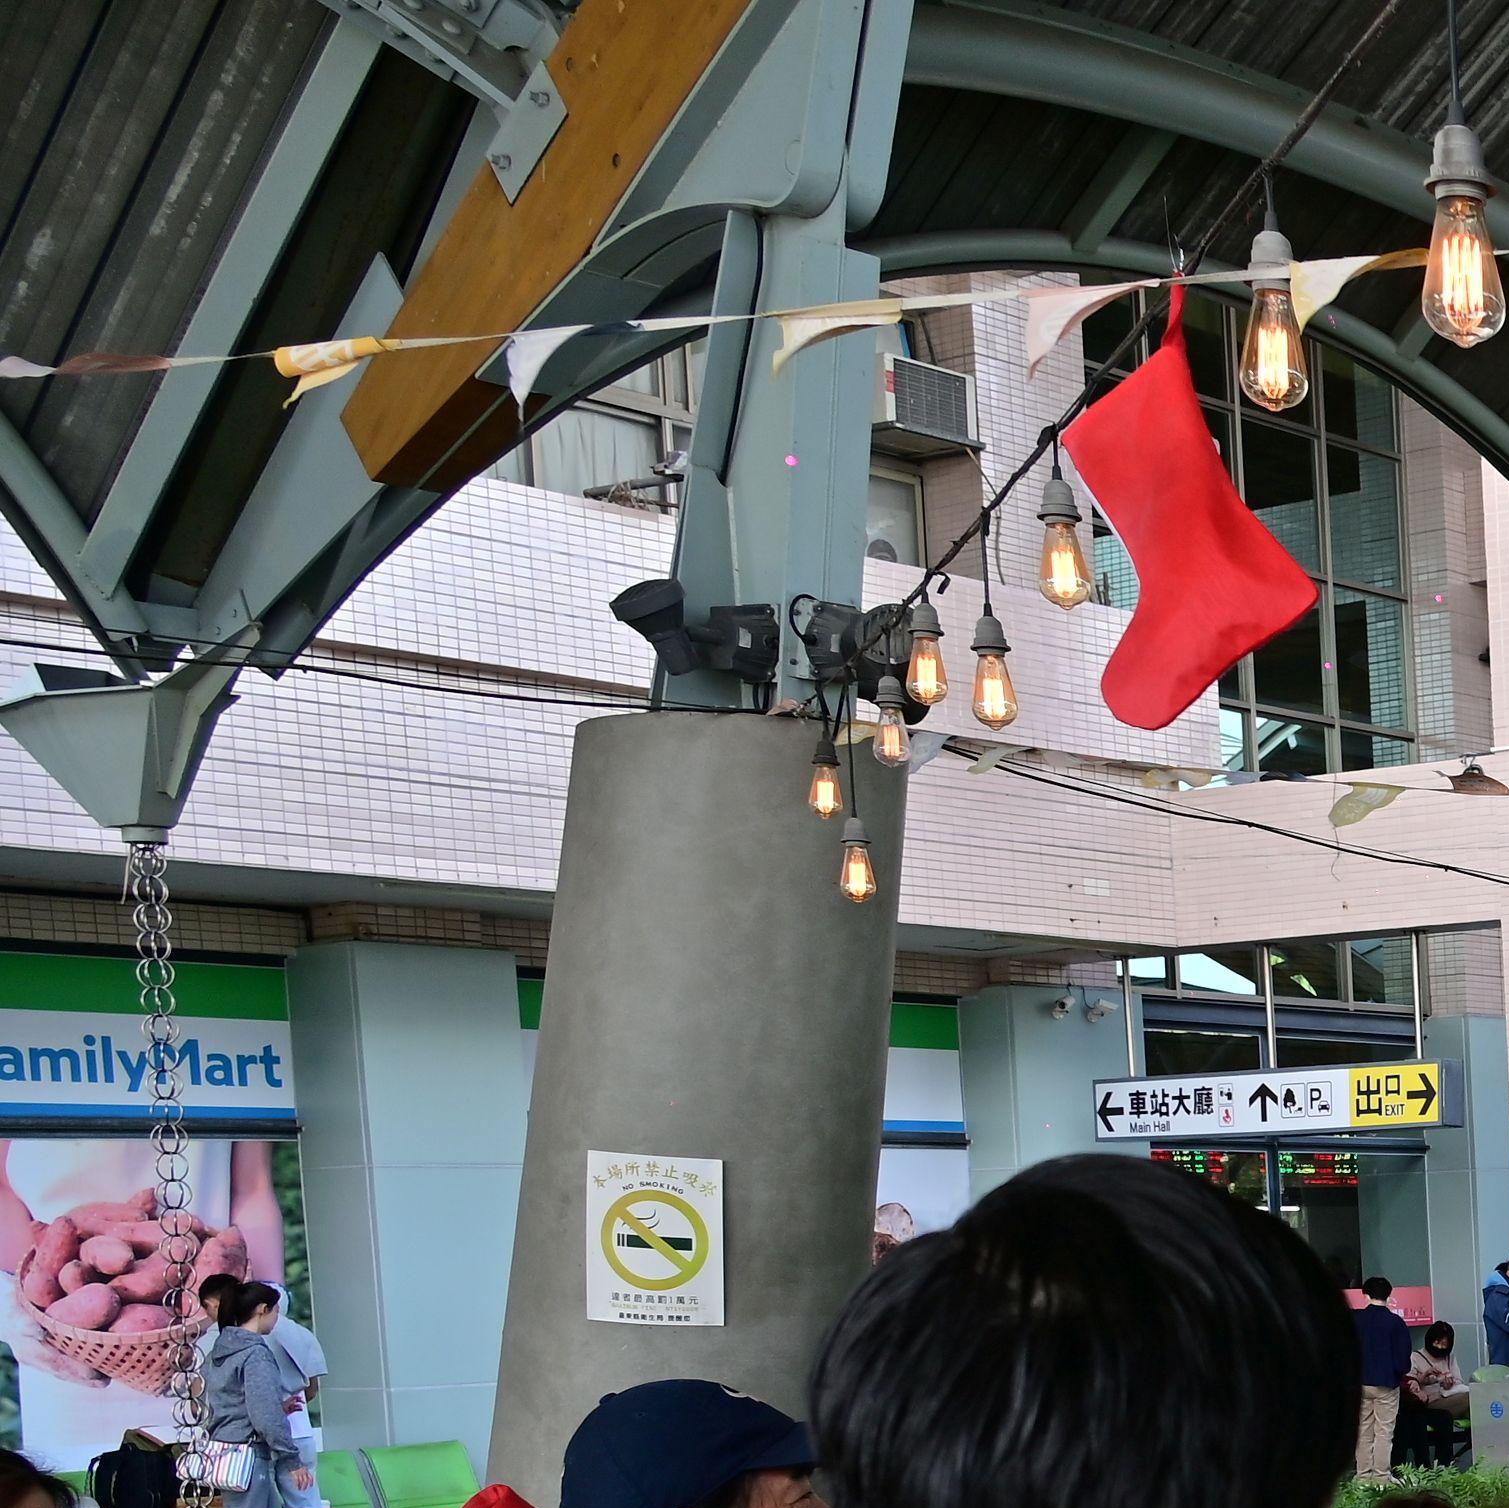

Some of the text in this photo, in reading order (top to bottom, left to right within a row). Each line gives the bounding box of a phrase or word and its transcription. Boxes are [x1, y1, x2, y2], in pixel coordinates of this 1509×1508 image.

[1128, 1085, 1214, 1119] 車站大廳
[1355, 1074, 1402, 1117] 出口
[1385, 1103, 1405, 1117] EXIT
[1129, 1119, 1171, 1134] Main Hall
[622, 1181, 684, 1195] NO SMOKING
